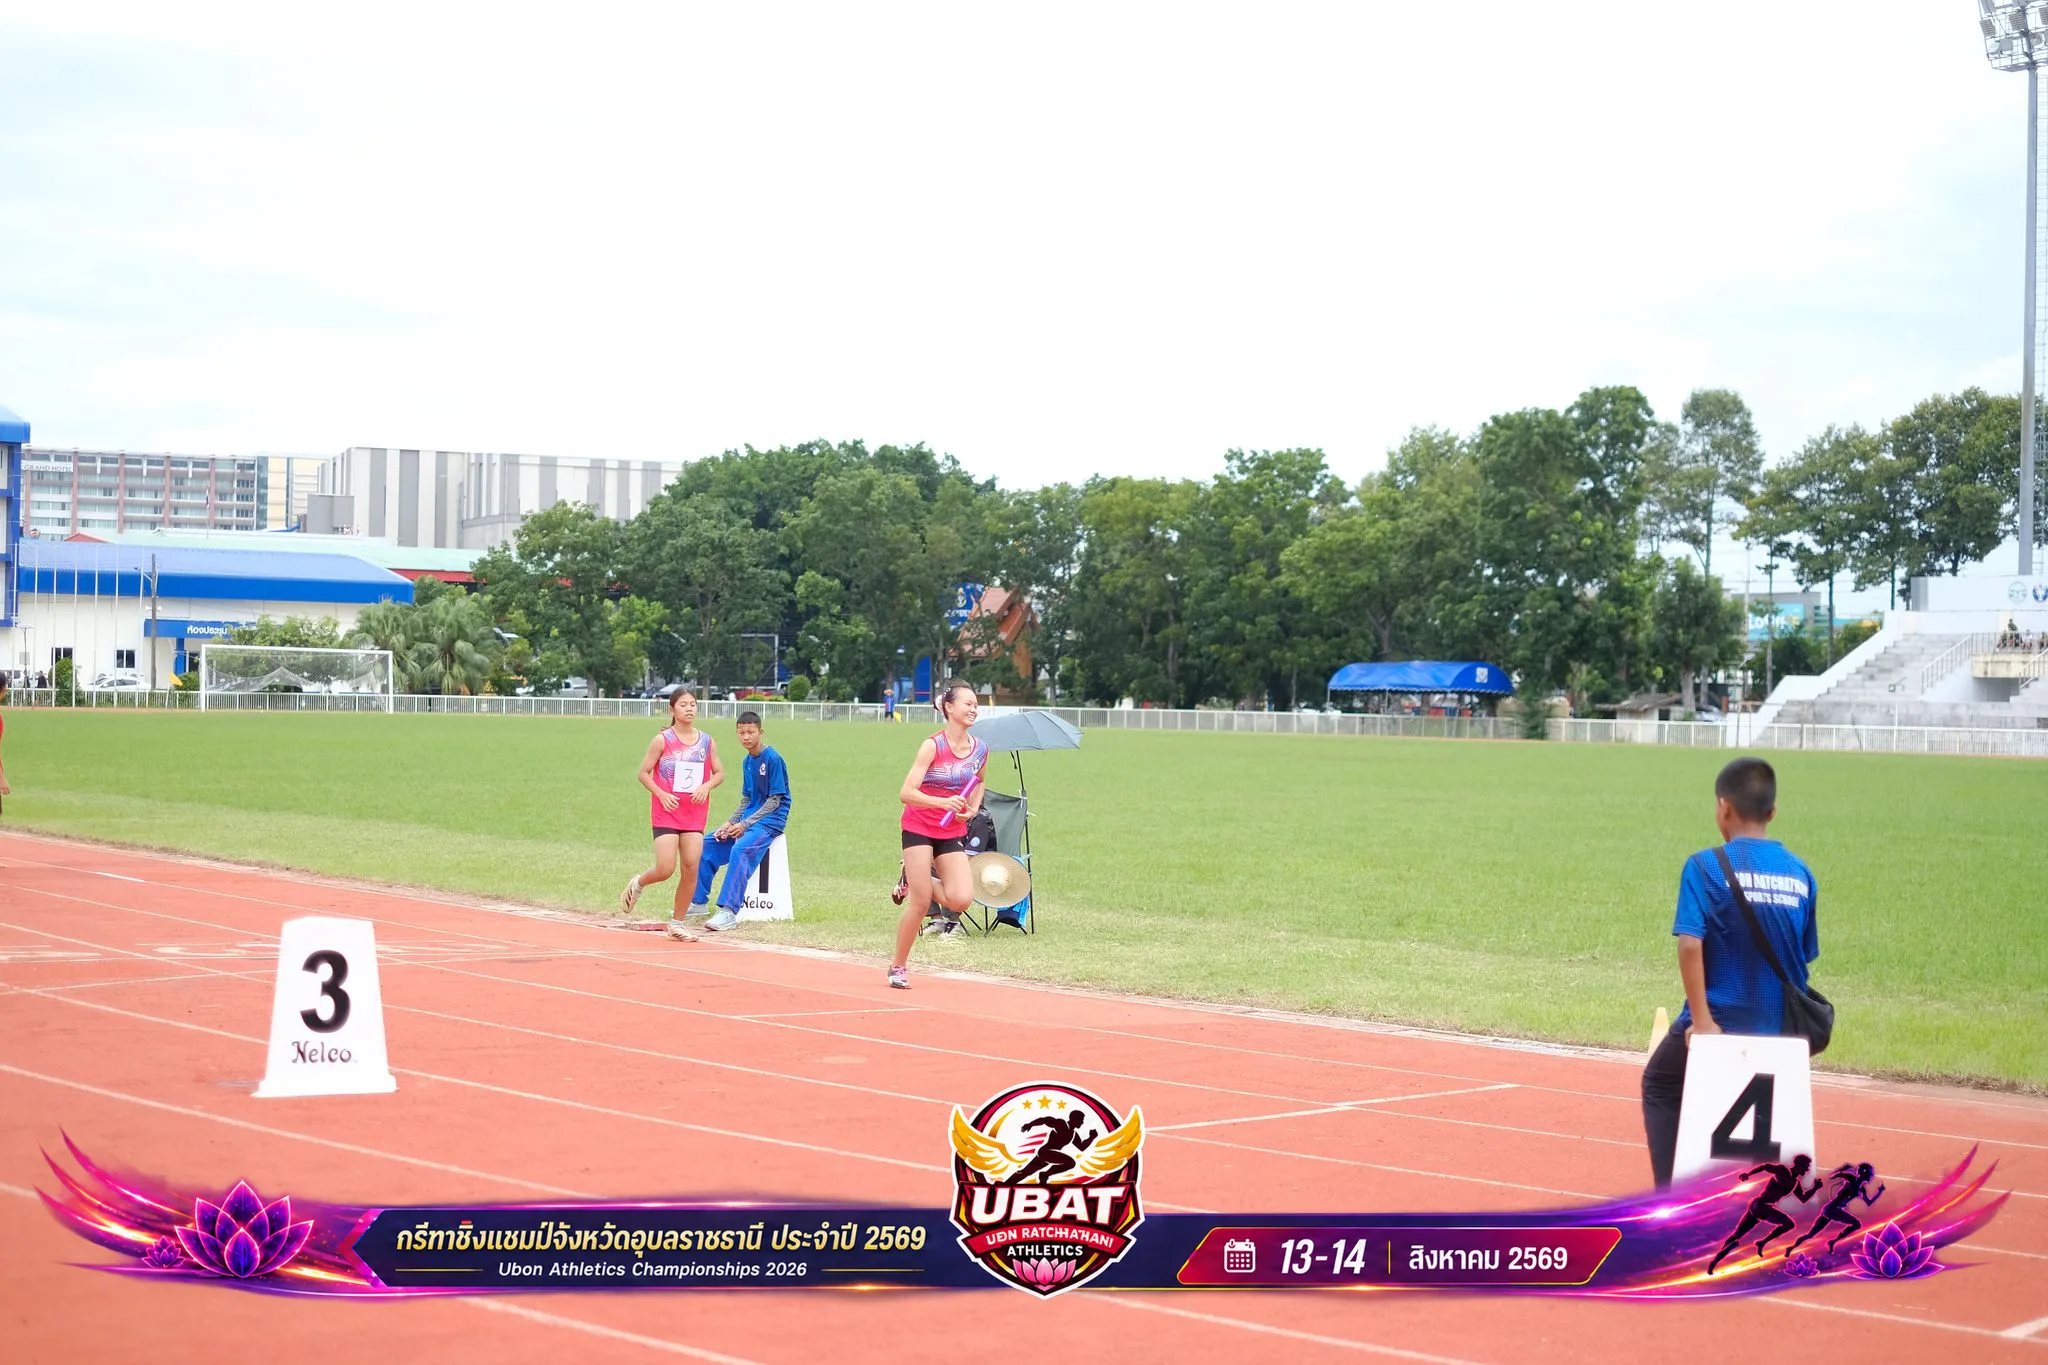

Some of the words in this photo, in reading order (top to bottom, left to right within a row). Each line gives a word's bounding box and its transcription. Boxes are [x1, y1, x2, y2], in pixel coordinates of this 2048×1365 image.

[681, 768, 694, 789] 3
[300, 949, 351, 1034] 3
[1710, 1072, 1782, 1164] 4
